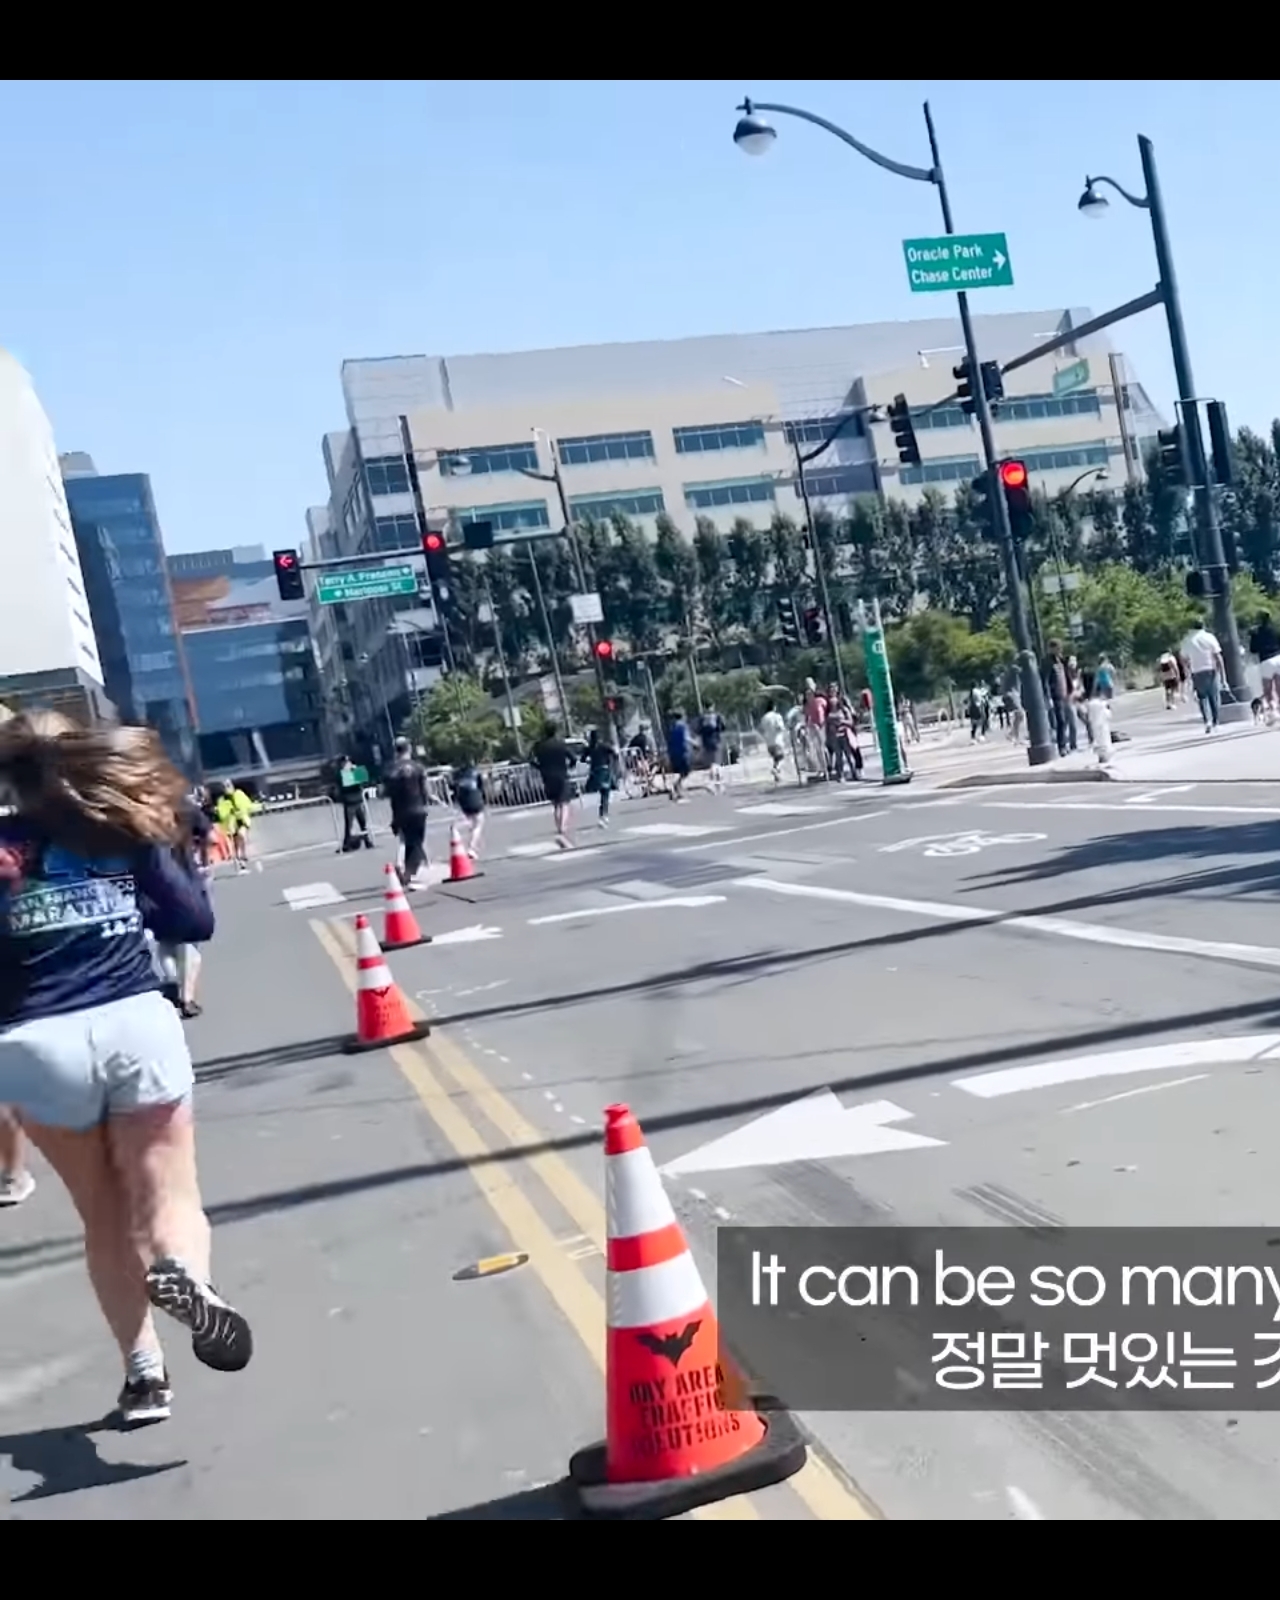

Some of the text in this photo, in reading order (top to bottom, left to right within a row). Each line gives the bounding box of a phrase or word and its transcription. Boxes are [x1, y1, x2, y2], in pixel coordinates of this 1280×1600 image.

[907, 243, 983, 262] Oracle Park
[911, 266, 992, 284] Chase Center
[676, 1363, 724, 1397] AREA
[641, 1390, 725, 1428] TRAFFIC
